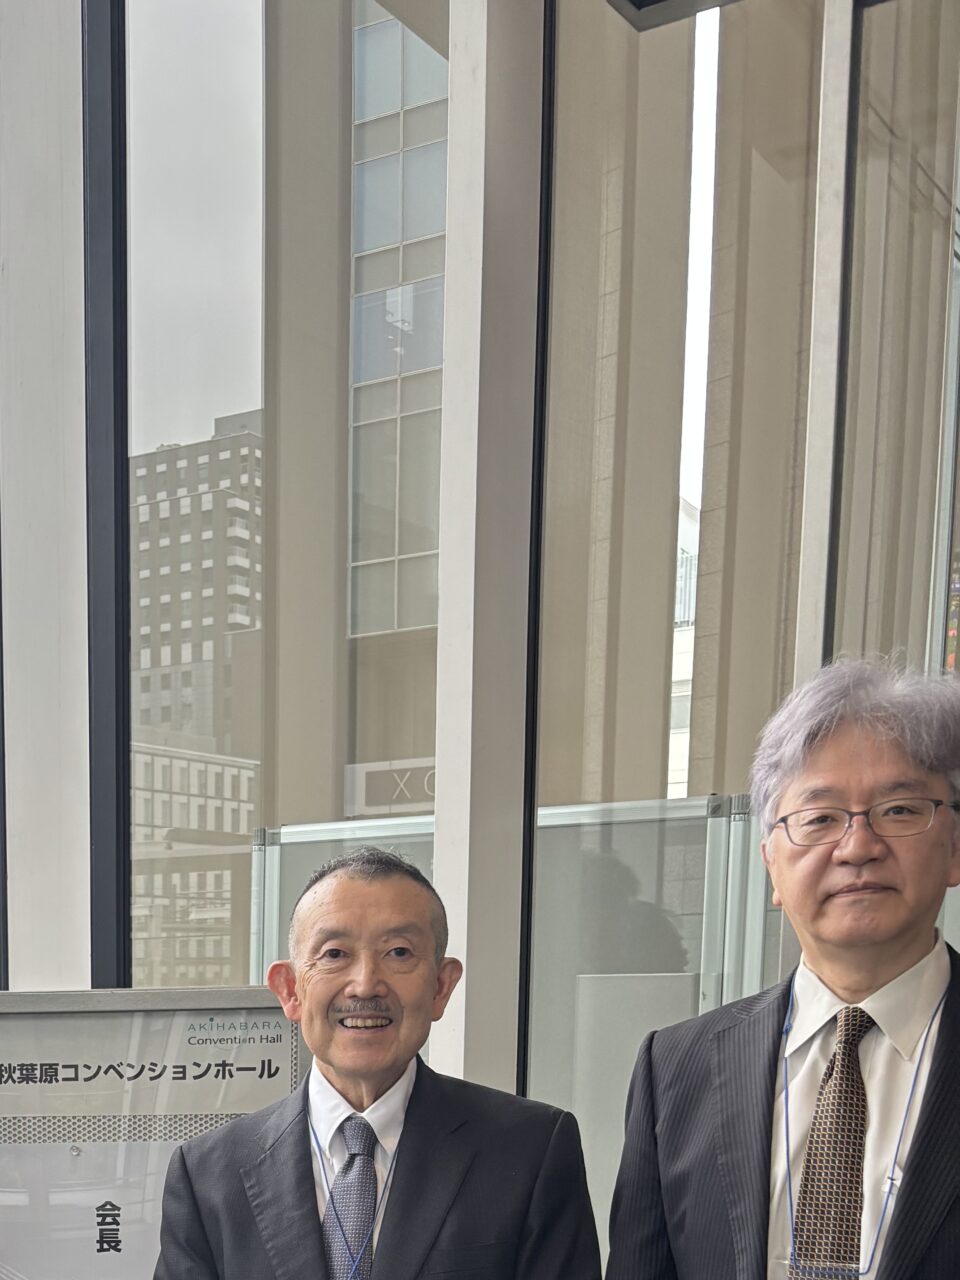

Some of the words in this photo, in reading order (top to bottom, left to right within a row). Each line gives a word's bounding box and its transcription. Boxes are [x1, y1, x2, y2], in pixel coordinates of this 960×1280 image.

[187, 1034, 256, 1046] Convention
[259, 1033, 282, 1044] Hall
[95, 1201, 122, 1253] 会長
